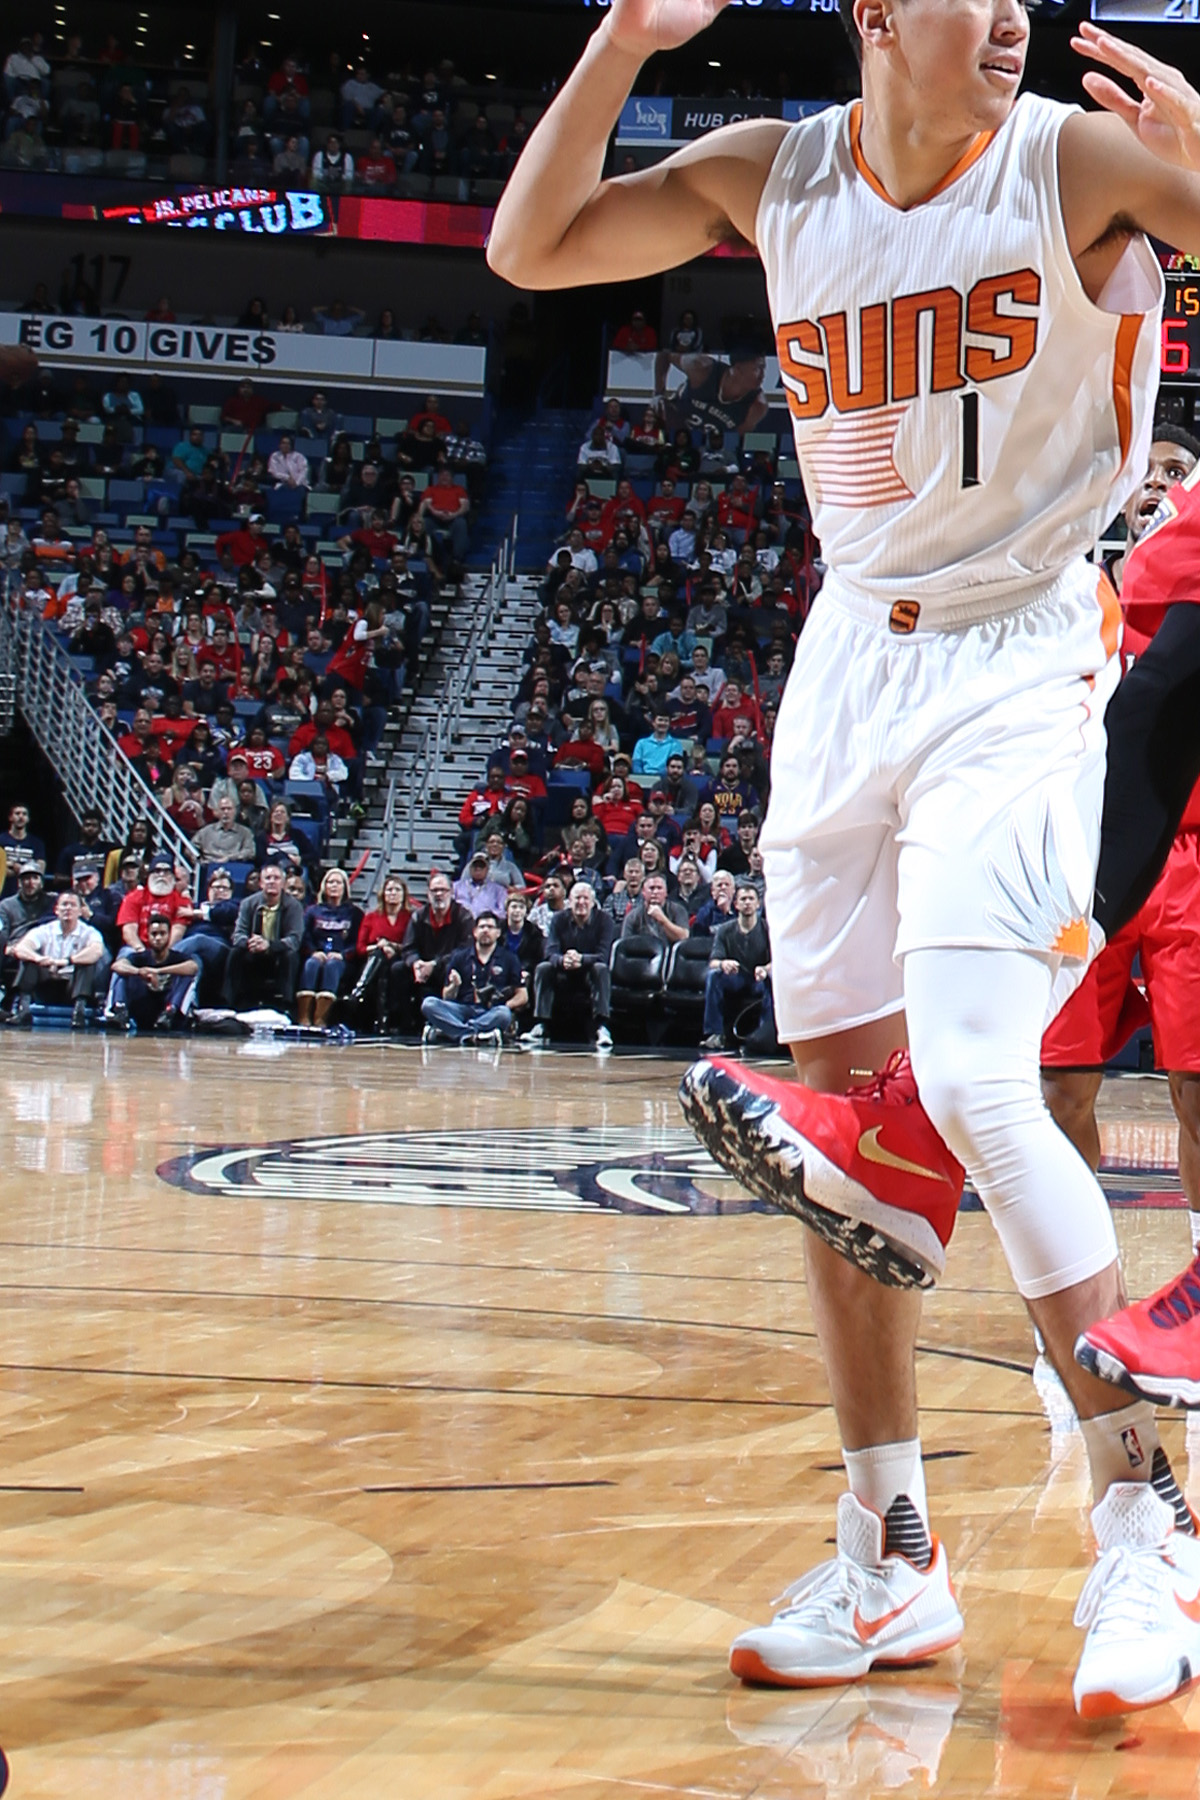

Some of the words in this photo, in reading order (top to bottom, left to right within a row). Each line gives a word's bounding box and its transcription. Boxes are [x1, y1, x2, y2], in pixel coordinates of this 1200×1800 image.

[684, 112, 725, 129] HUB
[70, 253, 131, 302] 117
[18, 319, 74, 350] EG
[90, 324, 137, 354] 10
[150, 327, 276, 365] GIVES
[959, 390, 982, 490] 1
[253, 756, 272, 770] 23
